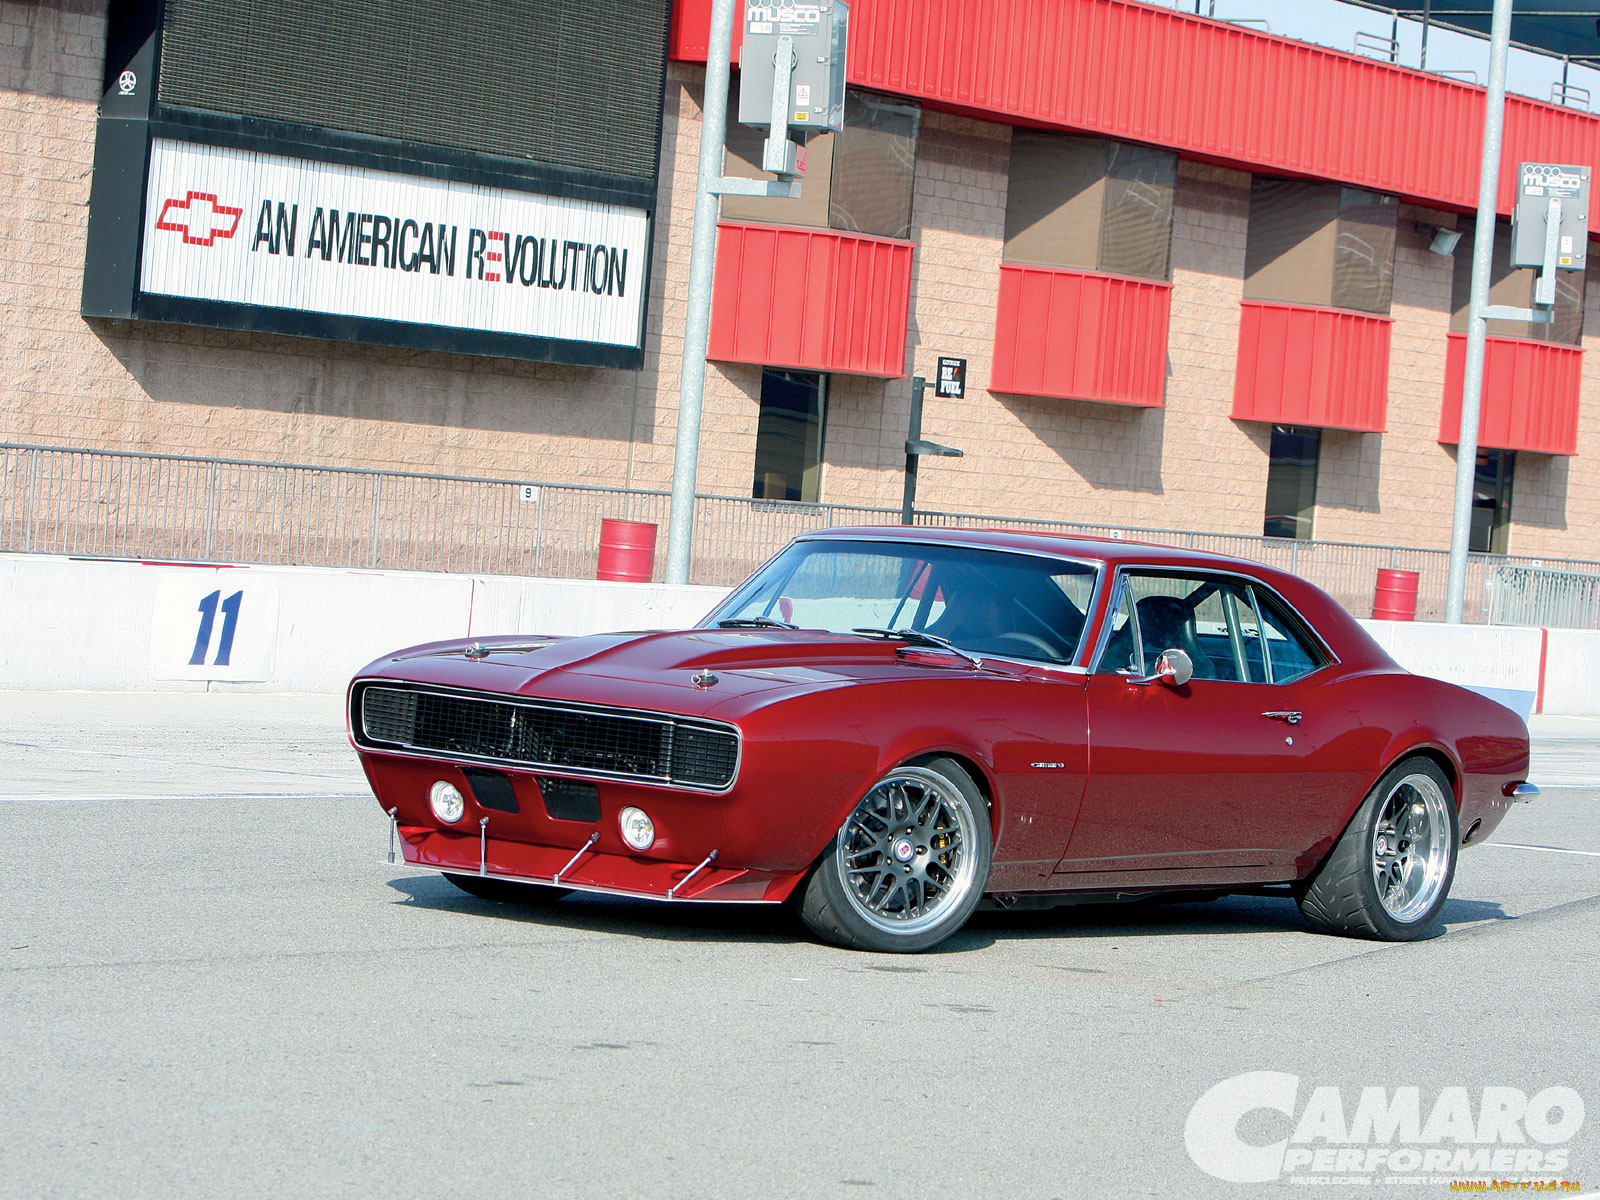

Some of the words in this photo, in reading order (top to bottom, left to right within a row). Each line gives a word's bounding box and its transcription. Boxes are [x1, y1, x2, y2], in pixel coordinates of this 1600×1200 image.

[252, 199, 298, 257] AN
[304, 207, 457, 278] AMERICAN
[466, 227, 629, 298] REVOLUTION
[525, 487, 532, 498] 9
[188, 589, 244, 666] 11
